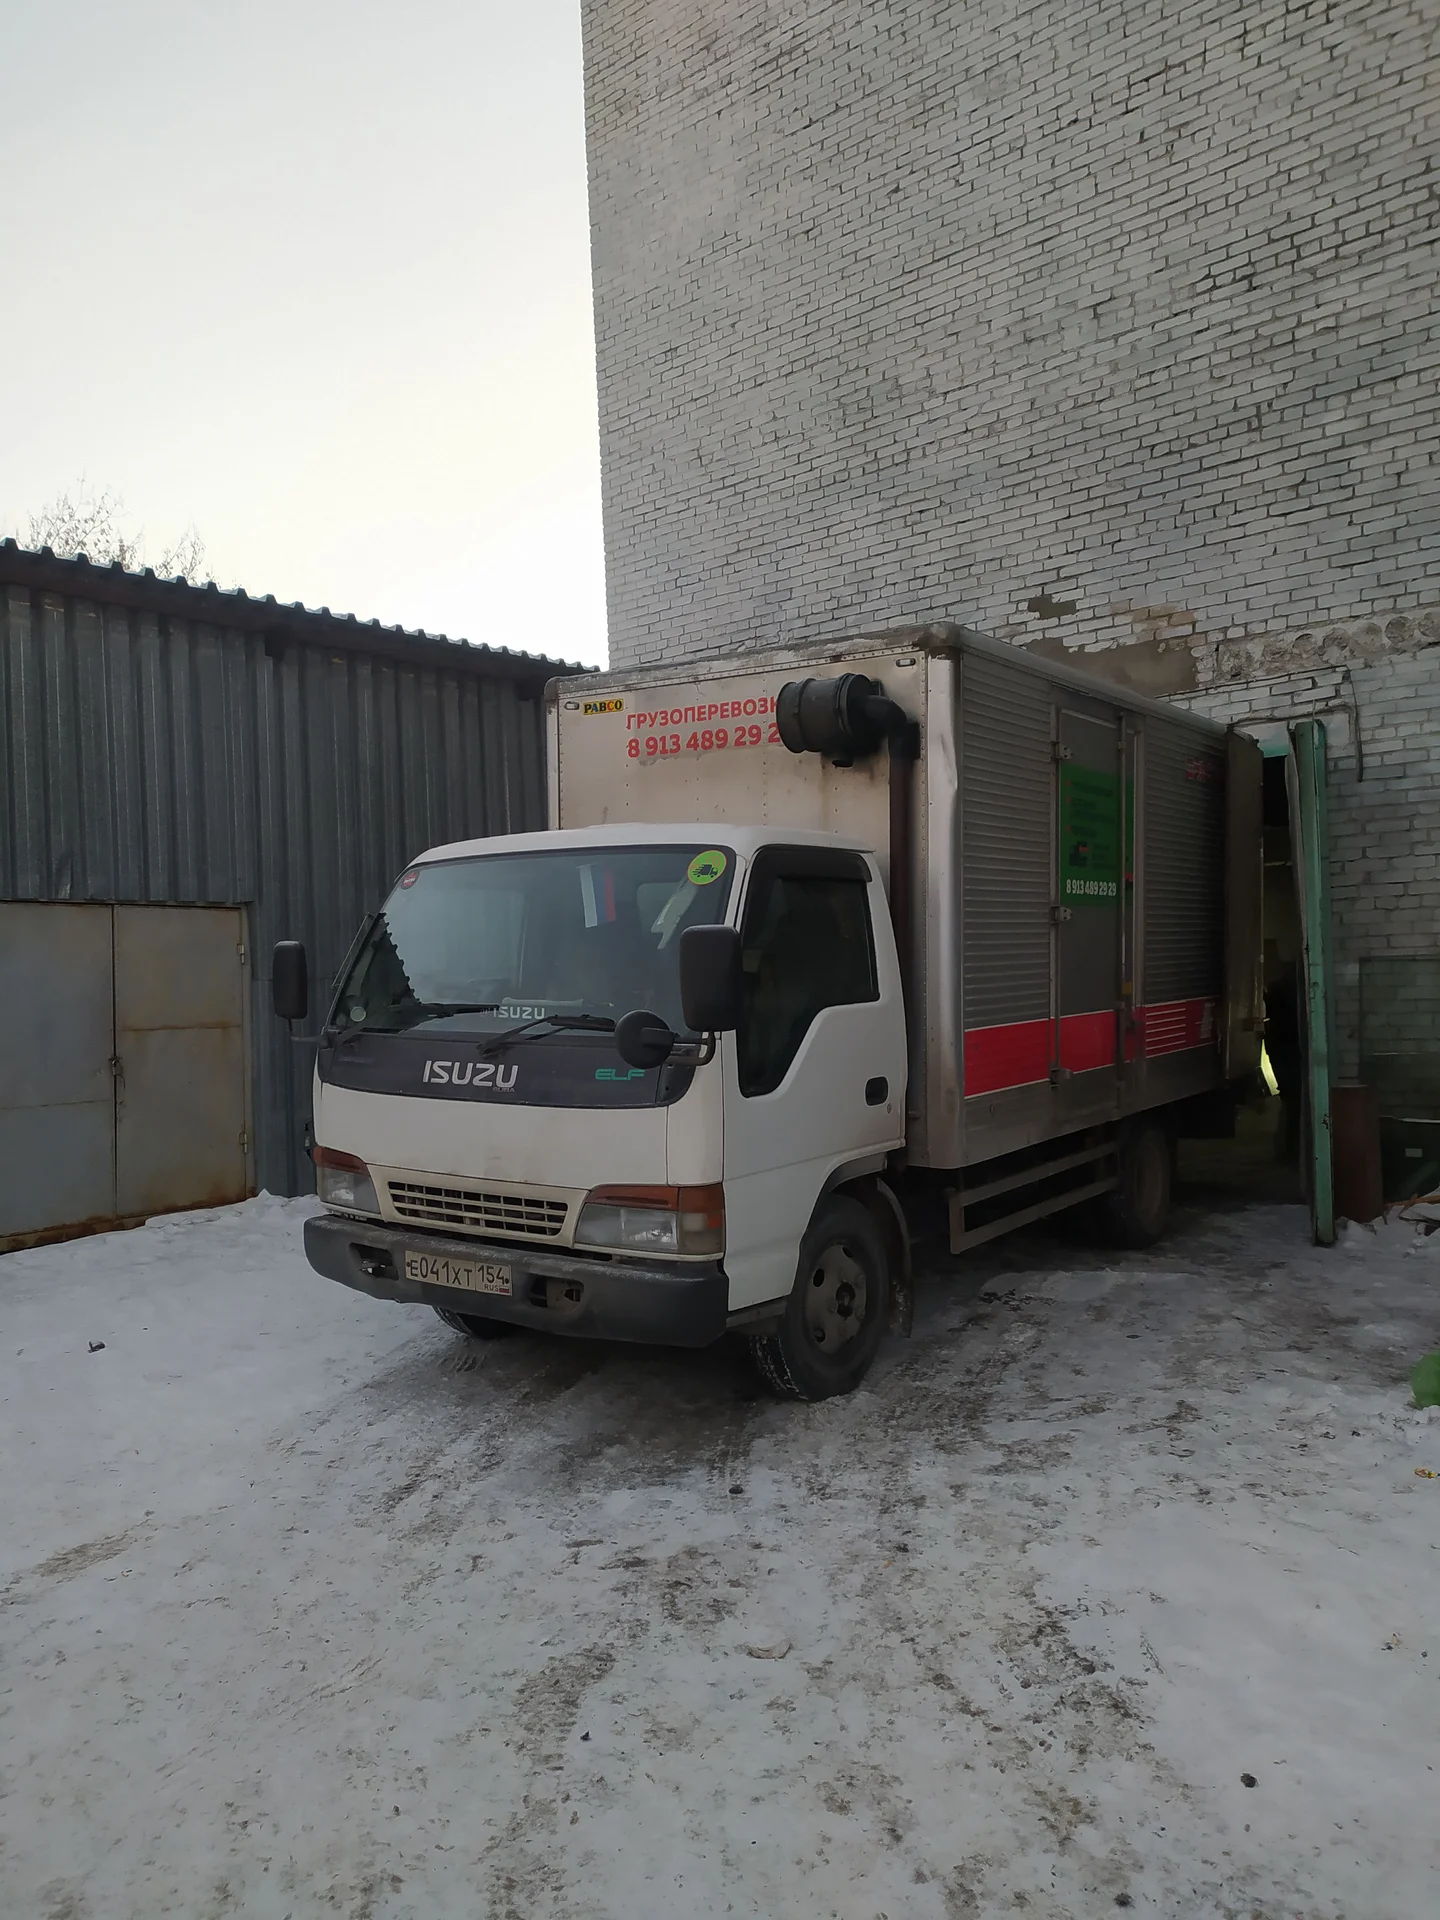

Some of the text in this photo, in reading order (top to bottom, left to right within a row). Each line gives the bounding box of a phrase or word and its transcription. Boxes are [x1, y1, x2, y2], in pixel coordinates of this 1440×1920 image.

[584, 700, 623, 714] PABCO
[626, 695, 777, 730] ГРУЗОПЕРЕВОЗ
[628, 721, 781, 758] 8 913 489 29 2
[1066, 878, 1117, 897] 8 913 489 29 29
[493, 1006, 545, 1020] ISUZU
[422, 1060, 519, 1088] ISUZU
[595, 1068, 645, 1081] ELF
[477, 1264, 505, 1285] 154
[484, 1284, 499, 1292] RUS
